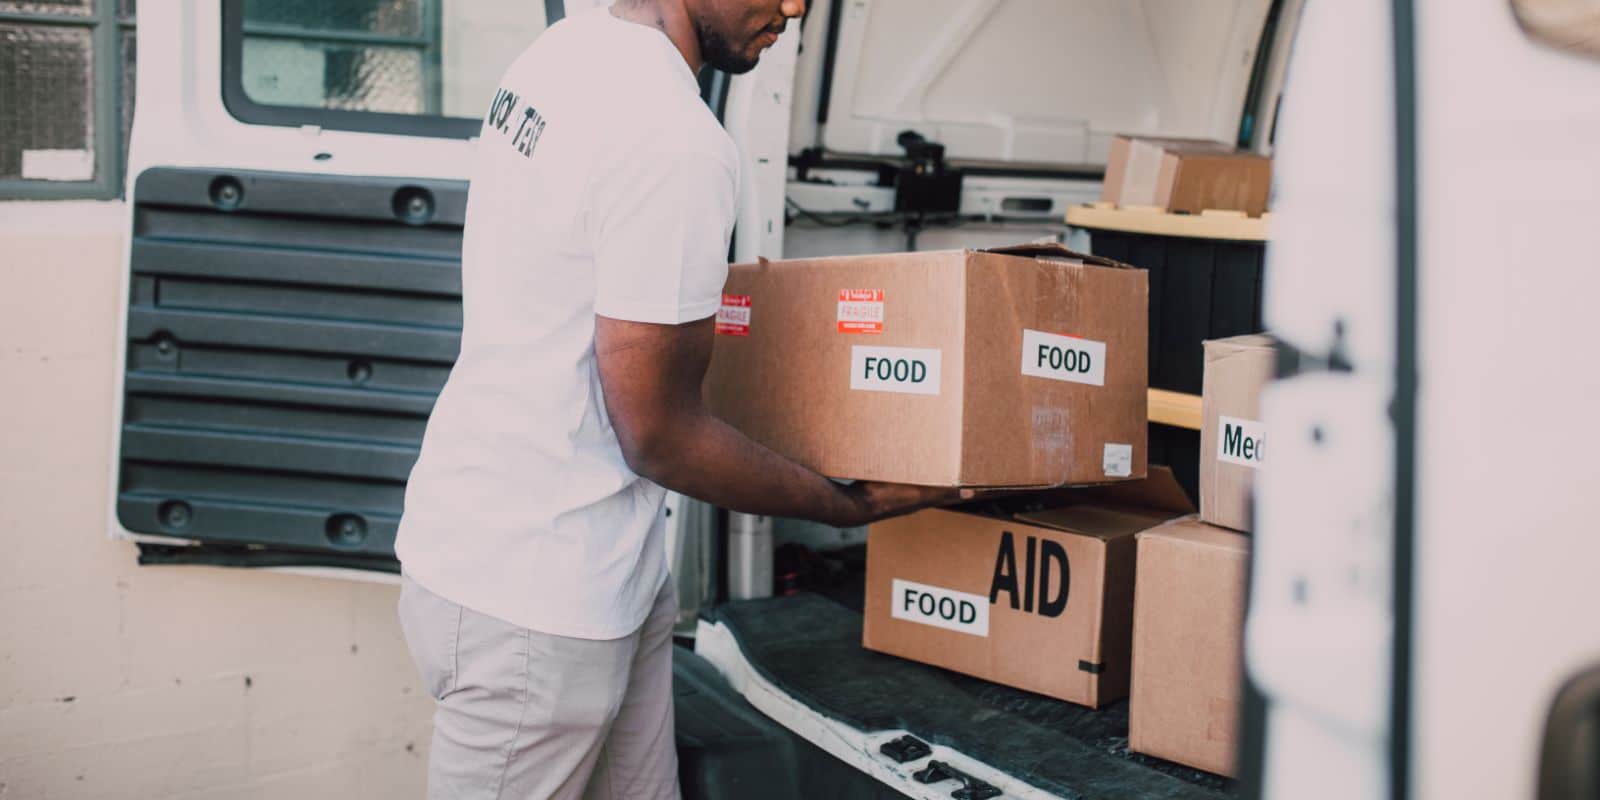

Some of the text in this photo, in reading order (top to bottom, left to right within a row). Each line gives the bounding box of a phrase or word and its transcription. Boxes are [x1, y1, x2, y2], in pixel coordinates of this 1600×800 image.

[717, 308, 747, 322] RAGILE
[864, 357, 927, 383] FOOD
[1038, 343, 1091, 374] FOOD
[989, 531, 1071, 618] AID
[904, 589, 977, 624] FOOD
